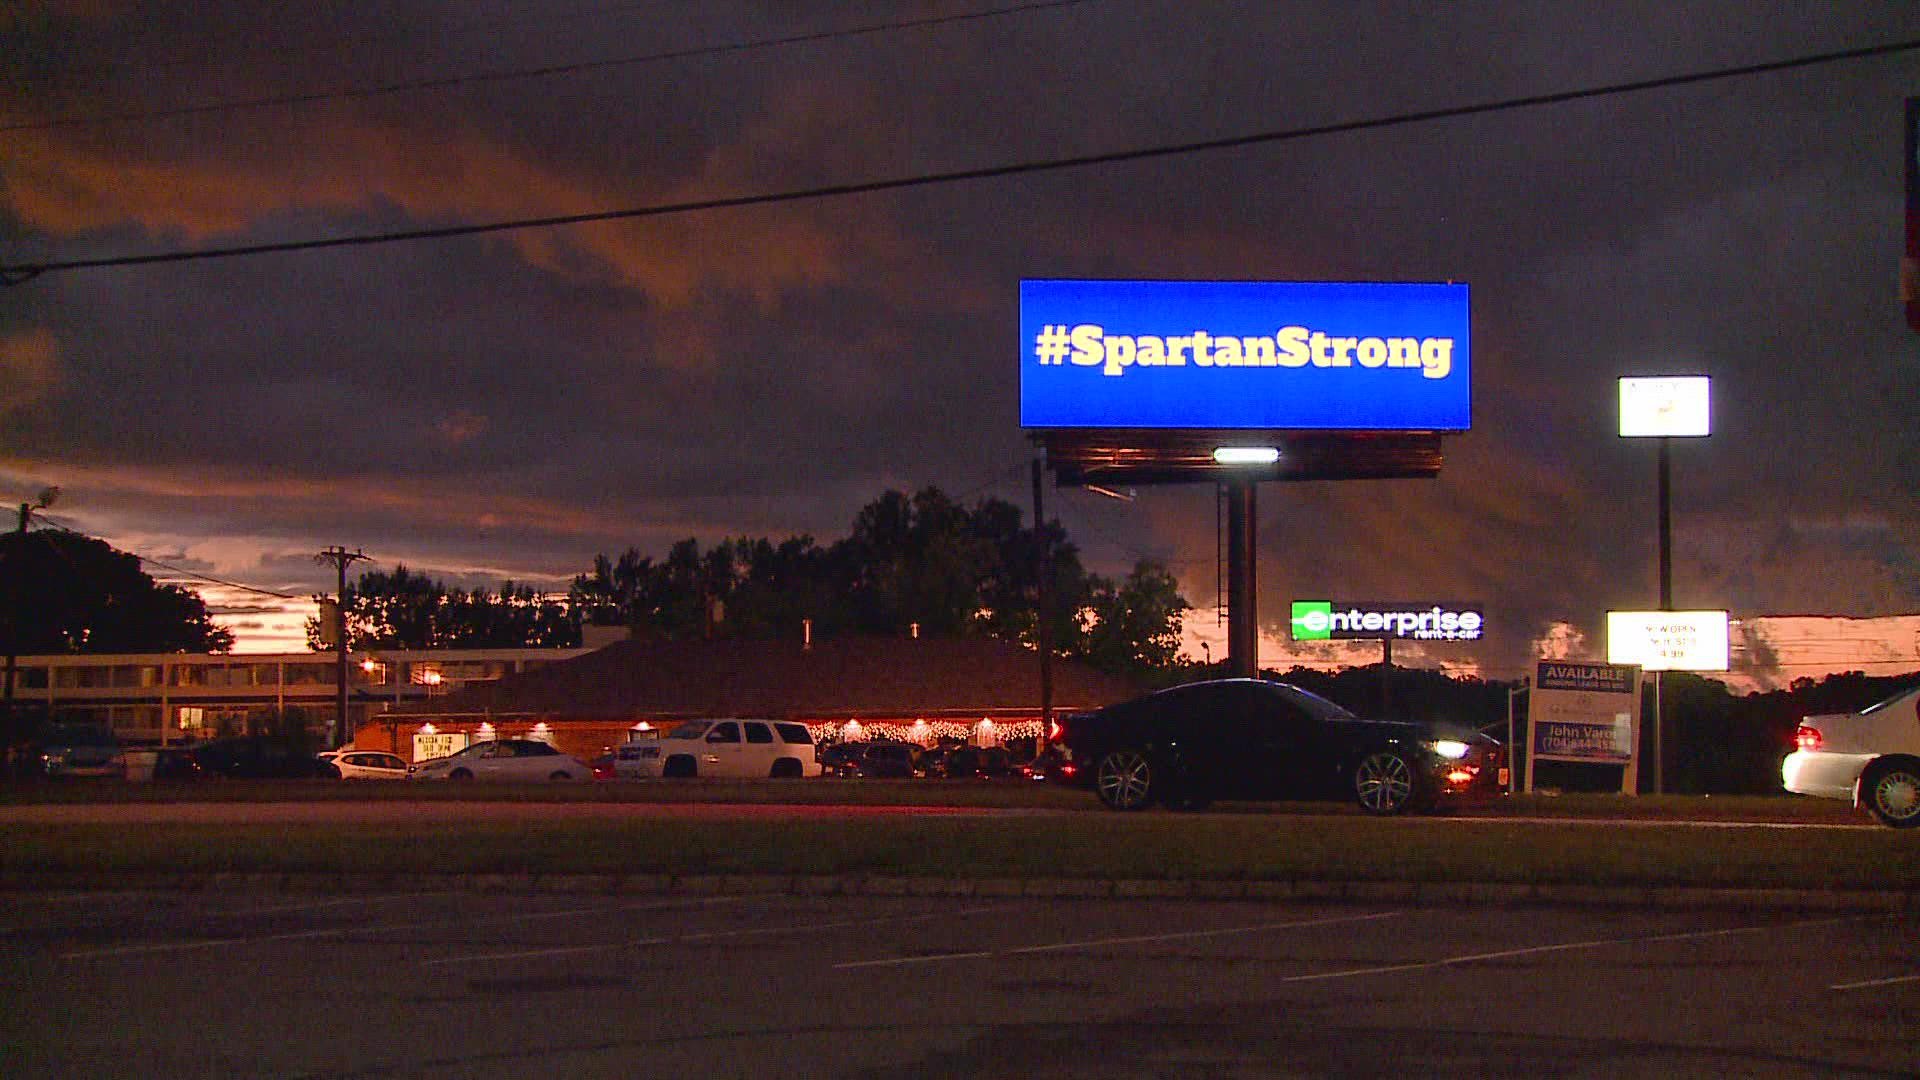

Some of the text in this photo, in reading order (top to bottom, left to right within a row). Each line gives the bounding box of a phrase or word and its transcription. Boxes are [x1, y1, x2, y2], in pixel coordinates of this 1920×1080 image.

[1035, 323, 1454, 379] #SpartanStrong
[1302, 606, 1482, 636] enterprise
[1413, 630, 1482, 640] rent-a-car
[1546, 666, 1625, 681] AVAILABLE
[1550, 724, 1580, 738] John
